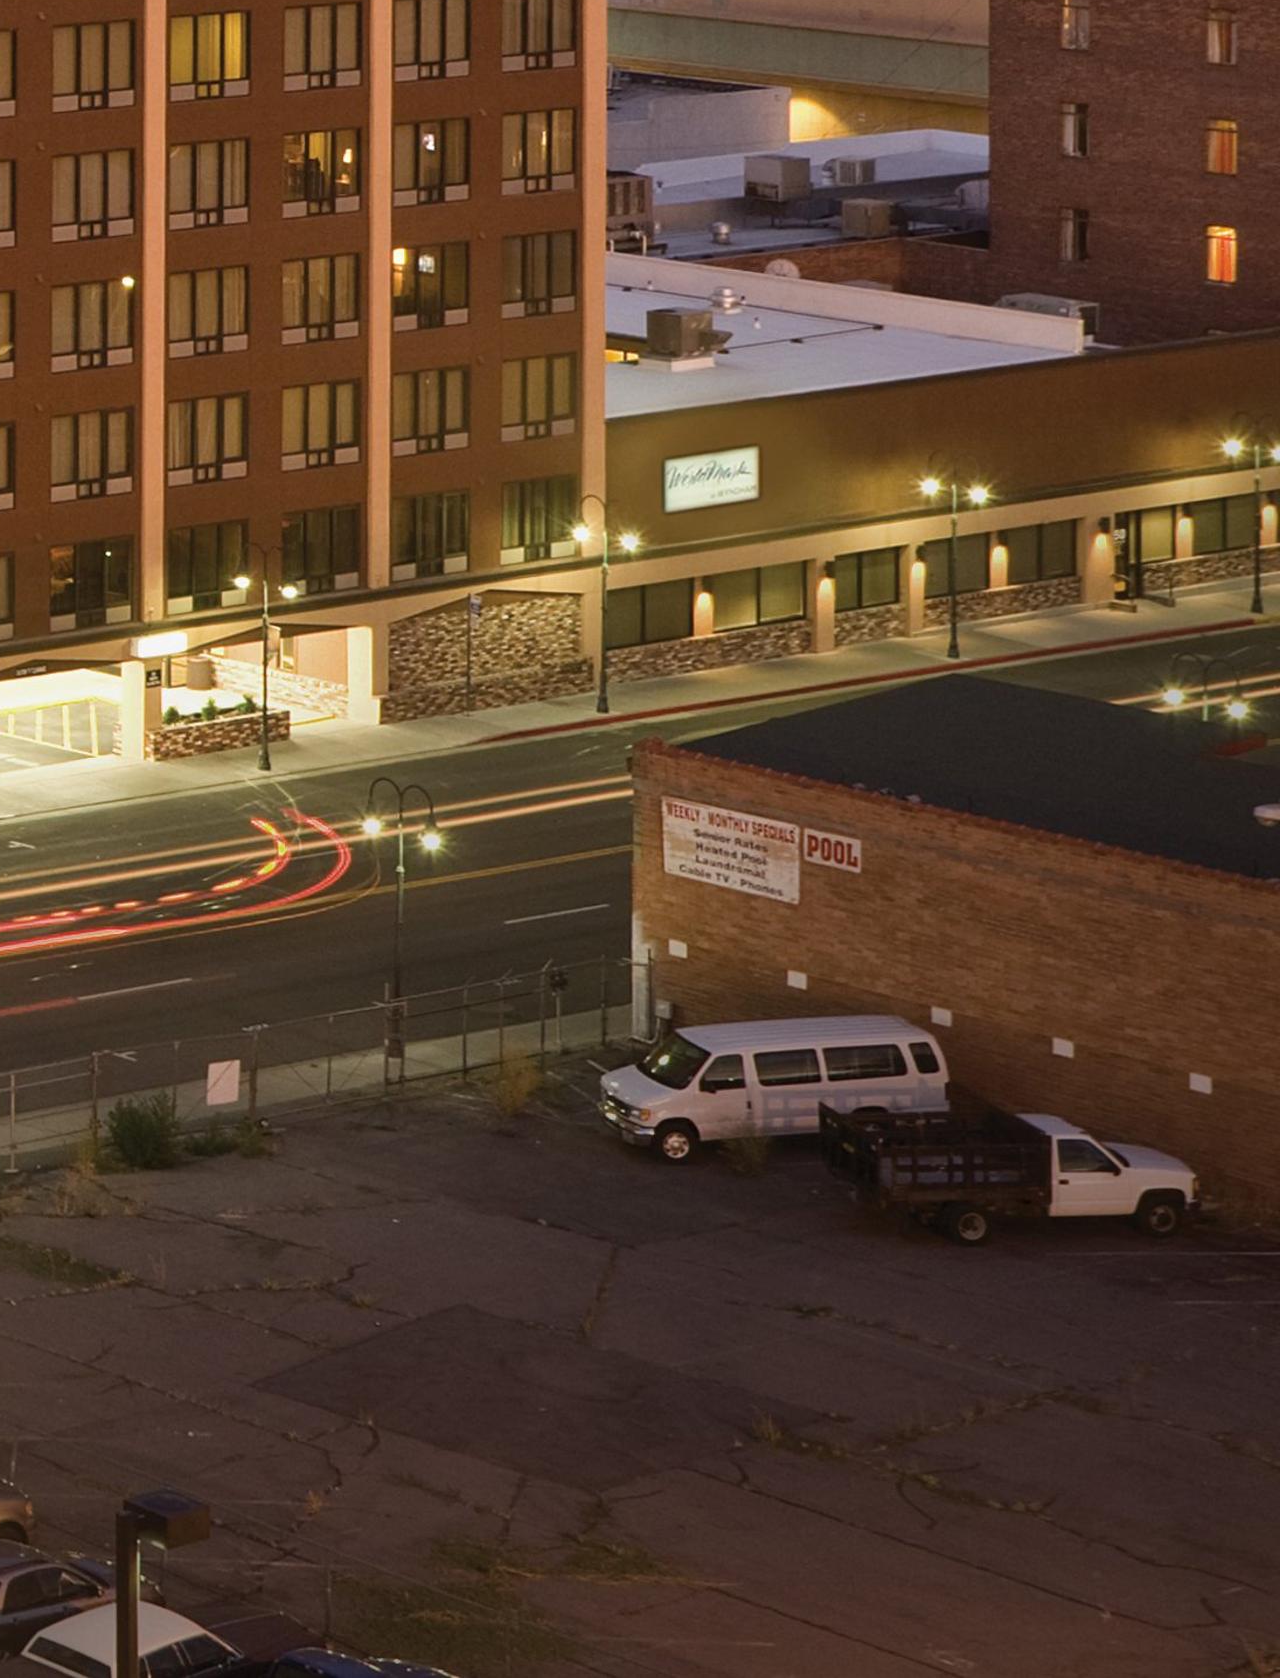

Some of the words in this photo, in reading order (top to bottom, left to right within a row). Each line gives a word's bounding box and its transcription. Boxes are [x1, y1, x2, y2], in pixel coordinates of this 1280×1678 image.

[665, 802, 700, 822] WEEKLY
[708, 811, 748, 833] MONTHLY
[751, 822, 795, 844] SPECIALS
[695, 843, 737, 859] Heated
[734, 837, 769, 853] Rates
[807, 834, 859, 868] POOL
[679, 864, 711, 879] Cable
[715, 872, 730, 883] TV
[740, 879, 783, 897] Phones
